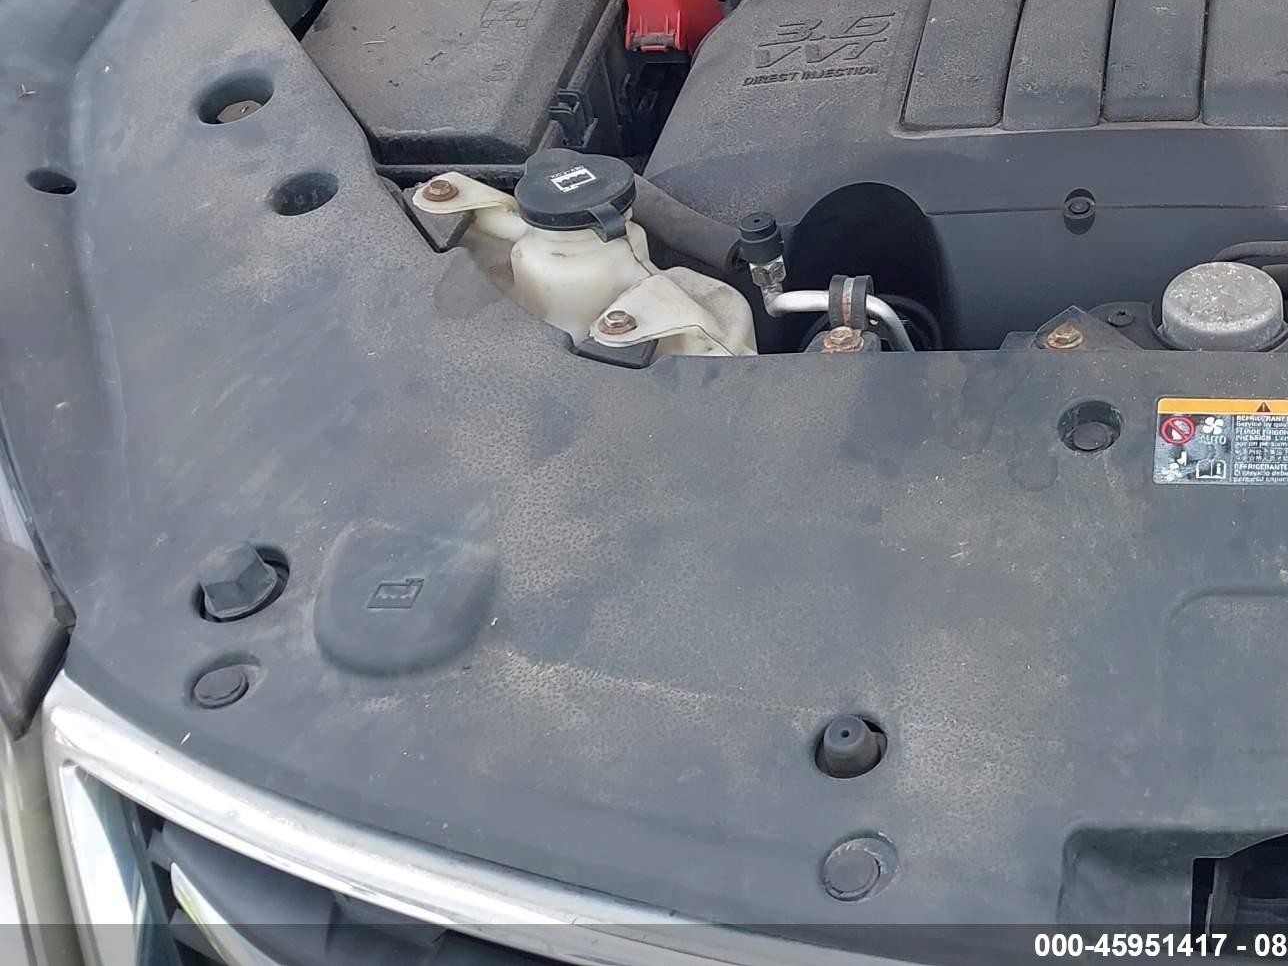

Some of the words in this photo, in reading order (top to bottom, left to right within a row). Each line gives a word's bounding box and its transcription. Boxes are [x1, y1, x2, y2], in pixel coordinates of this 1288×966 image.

[758, 12, 896, 47] 3.6
[753, 38, 888, 70] VVT
[742, 72, 800, 87] DIRECT
[801, 65, 880, 81] INJECTION
